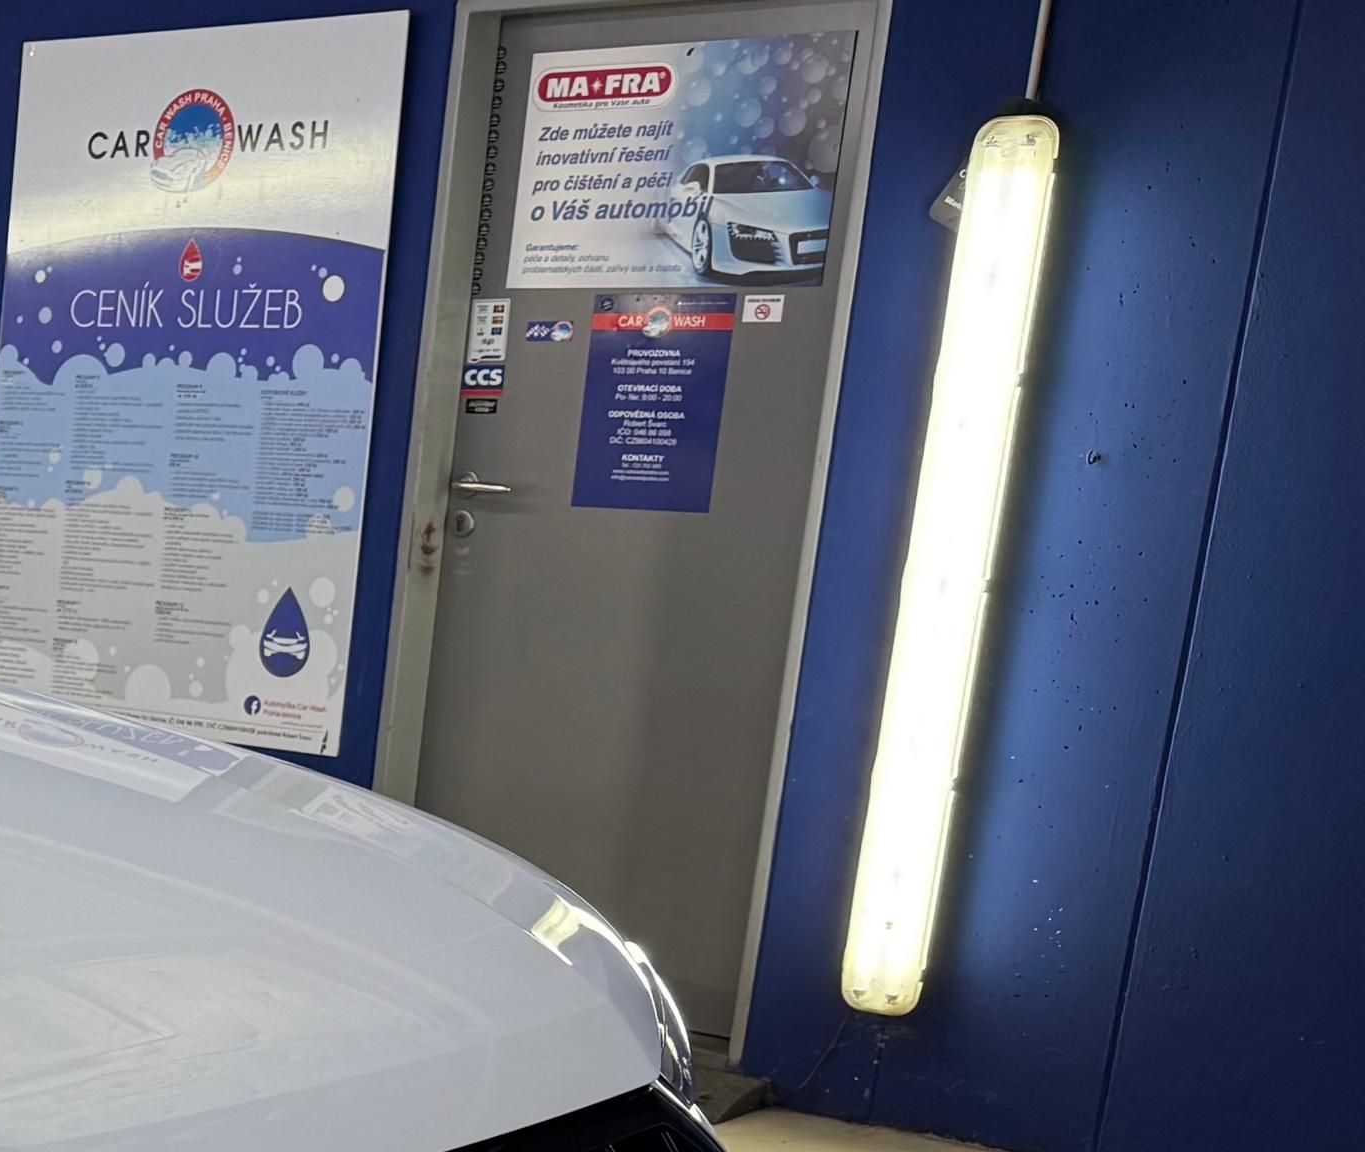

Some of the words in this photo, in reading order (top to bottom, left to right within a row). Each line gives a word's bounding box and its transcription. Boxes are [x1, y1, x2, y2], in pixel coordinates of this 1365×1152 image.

[595, 100, 609, 109] pro
[631, 98, 651, 106] auto
[155, 121, 169, 149] CAR
[164, 93, 192, 120] WASH
[194, 91, 226, 117] PRAHA
[538, 126, 569, 142] Zde
[573, 122, 632, 140] můžete
[636, 120, 674, 140] najít
[88, 130, 150, 159] CAR
[237, 120, 329, 152] WASH
[536, 147, 615, 166] inovativní
[618, 145, 672, 163] řešení
[532, 179, 560, 196] pro
[564, 173, 621, 190] čištění
[621, 177, 631, 188] a
[635, 172, 672, 192] péči
[530, 205, 545, 221] o
[552, 199, 590, 221] Váš
[595, 195, 714, 221] automobil
[70, 281, 164, 328] CENÍK
[177, 282, 303, 329] SLUŽEB
[618, 315, 643, 327] CAR
[674, 316, 706, 327] WASH
[464, 368, 503, 386] CCS
[636, 367, 657, 375] Praha
